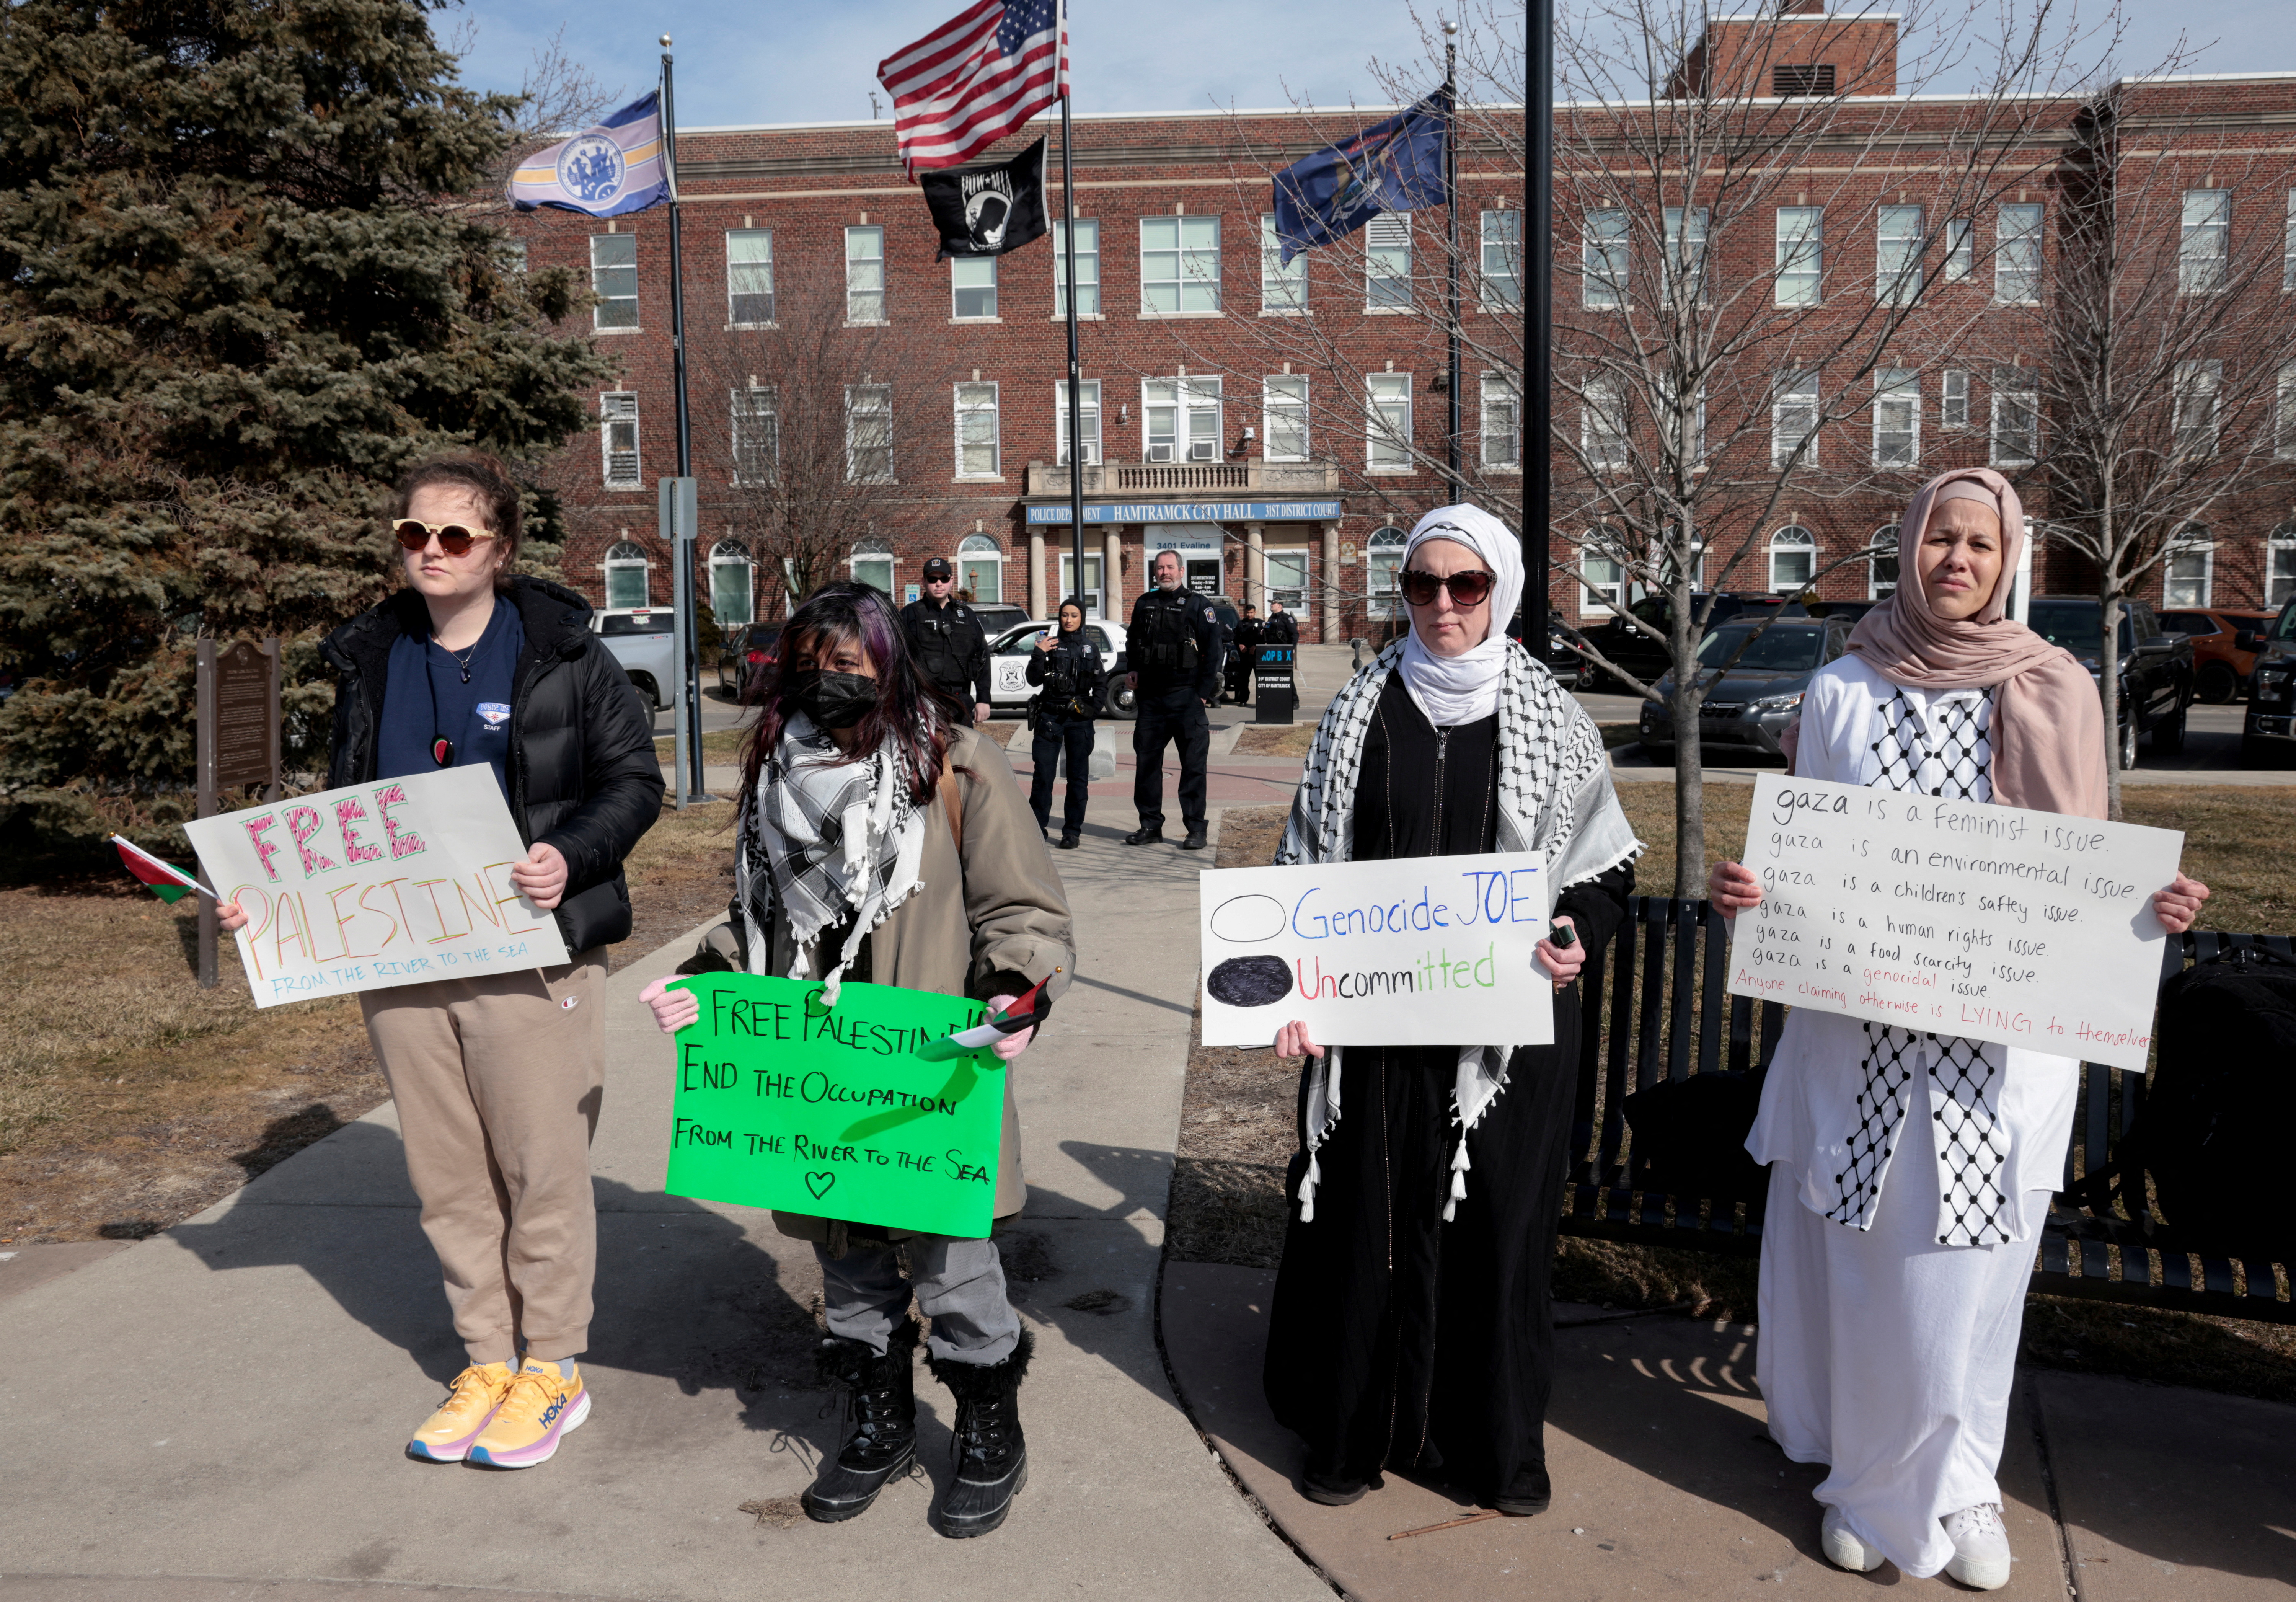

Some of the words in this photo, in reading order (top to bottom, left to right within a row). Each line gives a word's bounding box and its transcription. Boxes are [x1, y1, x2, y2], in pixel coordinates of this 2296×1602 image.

[613, 152, 621, 182] MICHIGAN
[1031, 508, 1055, 521] POLICE
[1057, 507, 1101, 520] DEPAMENT
[1114, 504, 1191, 520] HAMTRAMCK
[1193, 504, 1221, 520] CITY
[1223, 504, 1254, 519] HALL
[1265, 504, 1280, 517] 31ST
[1281, 504, 1312, 517] DISTRICT
[1313, 504, 1336, 516] COURT
[239, 783, 428, 884] FREE
[1773, 789, 1848, 825] gaza
[1868, 796, 1887, 820] is
[1906, 805, 1923, 821] a
[1934, 803, 2029, 841] feminist
[1769, 832, 1823, 858] gaza
[1852, 838, 1871, 857] is
[1891, 847, 1919, 865] an
[1928, 852, 2069, 886] environmental
[229, 861, 543, 981] PALESTINE
[1292, 885, 1450, 940] Genocide
[1456, 868, 1539, 926] JOE
[1763, 866, 1816, 893] gaza
[1843, 873, 1857, 891] is
[1870, 881, 1882, 893] a
[1894, 883, 1965, 906] children's
[1978, 895, 2027, 923] saftey
[1756, 924, 1801, 944] gaza
[1820, 936, 1831, 949] is
[1848, 943, 1856, 955] a
[1871, 941, 1900, 962] food
[1913, 953, 1972, 979] scarcity
[1759, 899, 1807, 919] gaza
[1832, 907, 1845, 923] is
[1859, 917, 1868, 928] a
[1887, 915, 1934, 939] human
[1948, 928, 1992, 953] rights
[271, 972, 332, 1000] FROM
[331, 965, 366, 989] THE
[373, 958, 435, 977] RIVER
[436, 953, 458, 967] TO
[461, 948, 491, 963] THE
[496, 942, 529, 958] SEA
[1297, 941, 1495, 1000] Uncommitted
[1752, 947, 1801, 966] gaza
[1816, 957, 1827, 971] is
[1843, 964, 1852, 975] a
[1863, 967, 1936, 989] genocidal
[712, 989, 792, 1040] FREE
[1735, 968, 1786, 995] Anyone
[1798, 981, 1847, 1009] claiming
[1860, 991, 1918, 1014] otherwise
[1930, 1005, 1943, 1018] is
[1961, 1003, 2031, 1034] LYING
[2047, 1016, 2064, 1036] to
[683, 1044, 737, 1093] END
[753, 1070, 796, 1099] THE
[801, 1072, 957, 1116] OCCUPATION
[675, 1117, 732, 1149] FROM
[744, 1133, 785, 1155] THE
[794, 1134, 858, 1164] RIVER
[864, 1149, 890, 1166] TO
[895, 1151, 937, 1173] THE
[944, 1149, 990, 1186] SEA
[525, 1365, 543, 1374] HOKA
[538, 1393, 567, 1430] HOKA
